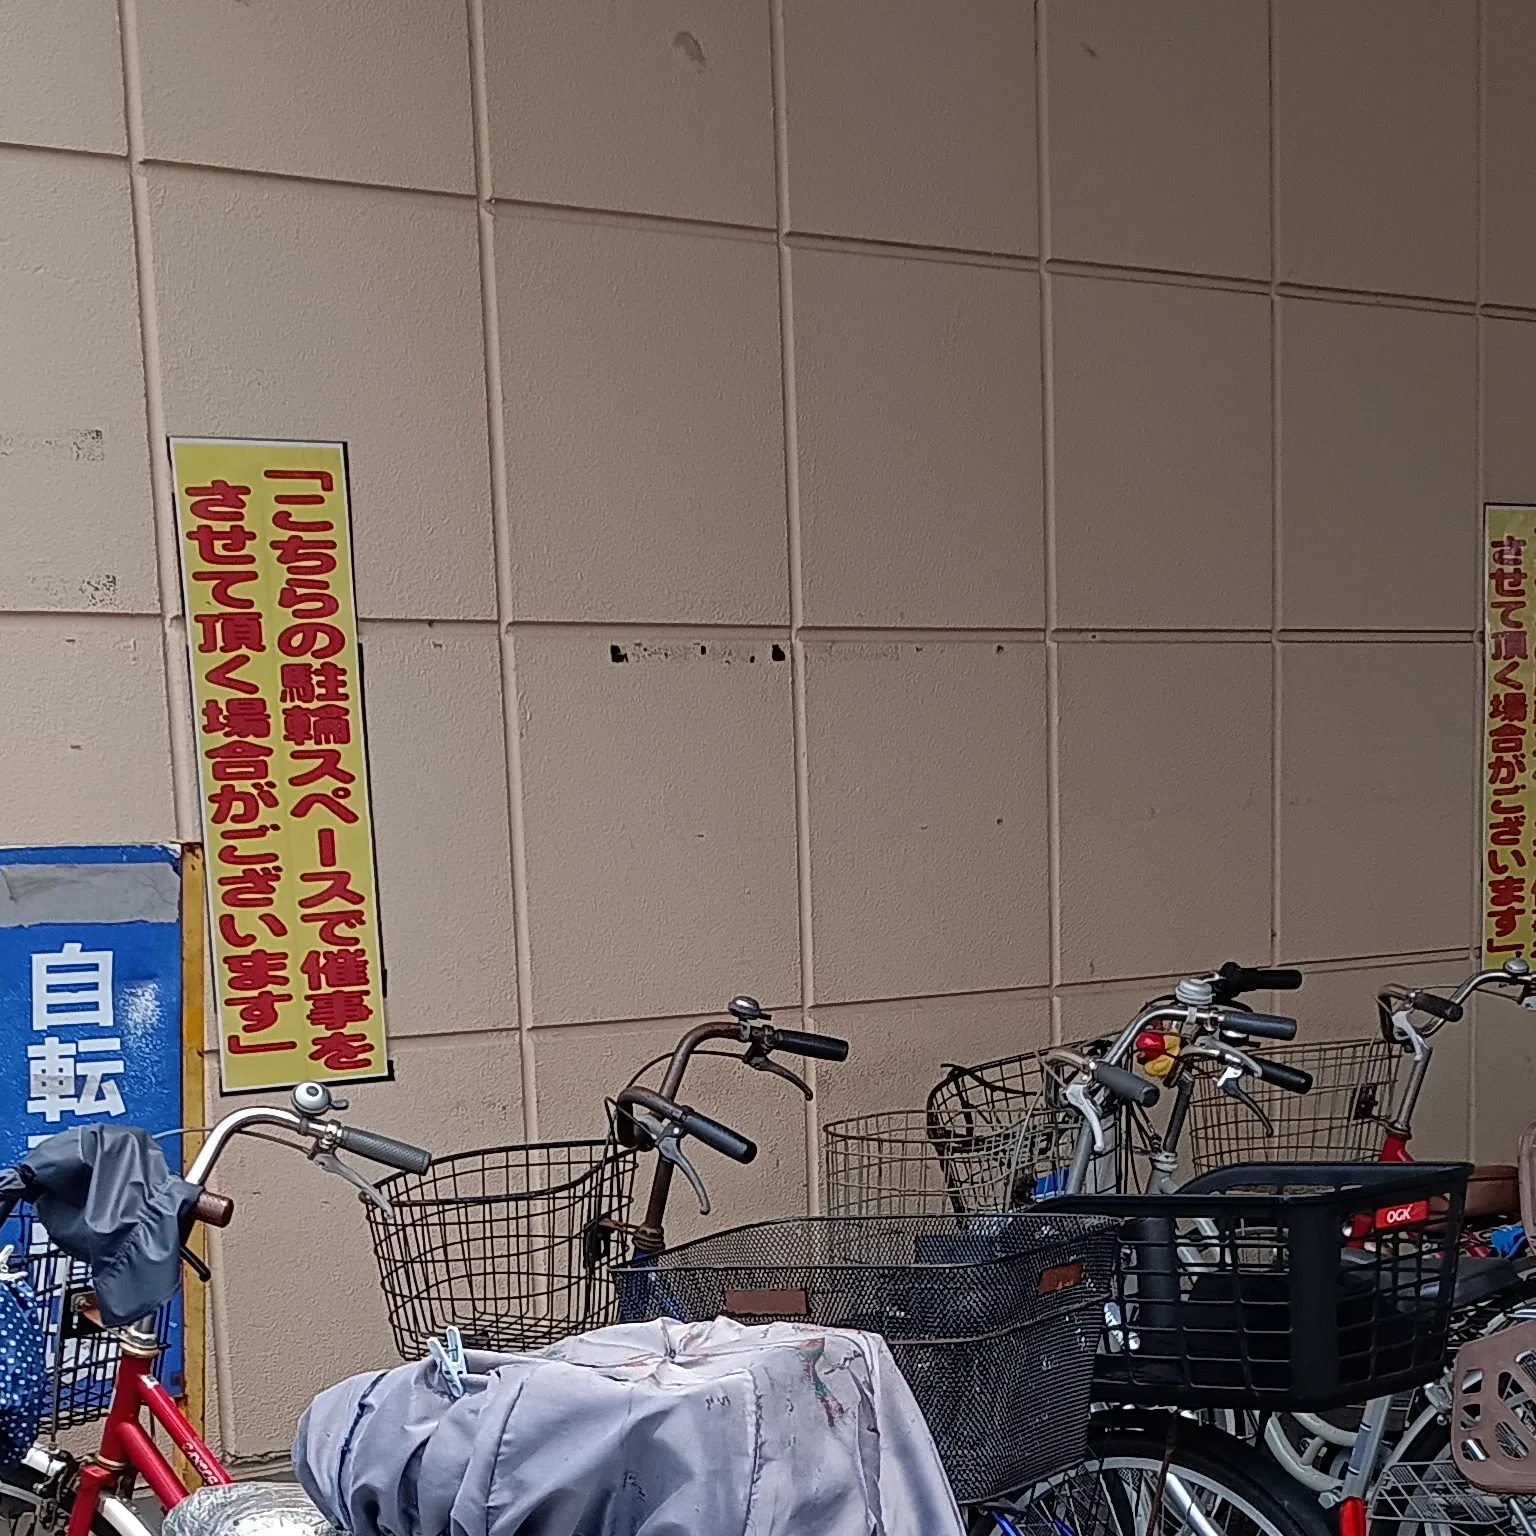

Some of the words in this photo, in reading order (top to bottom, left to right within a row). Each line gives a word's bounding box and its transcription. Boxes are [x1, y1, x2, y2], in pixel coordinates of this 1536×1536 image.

[184, 479, 296, 1054] させて頂く場合がございます」
[263, 469, 374, 1071] 「こちらの駐輪スペースで催事を
[1488, 536, 1529, 954] させて頂く場合がございます」
[1386, 1203, 1414, 1224] OGK
